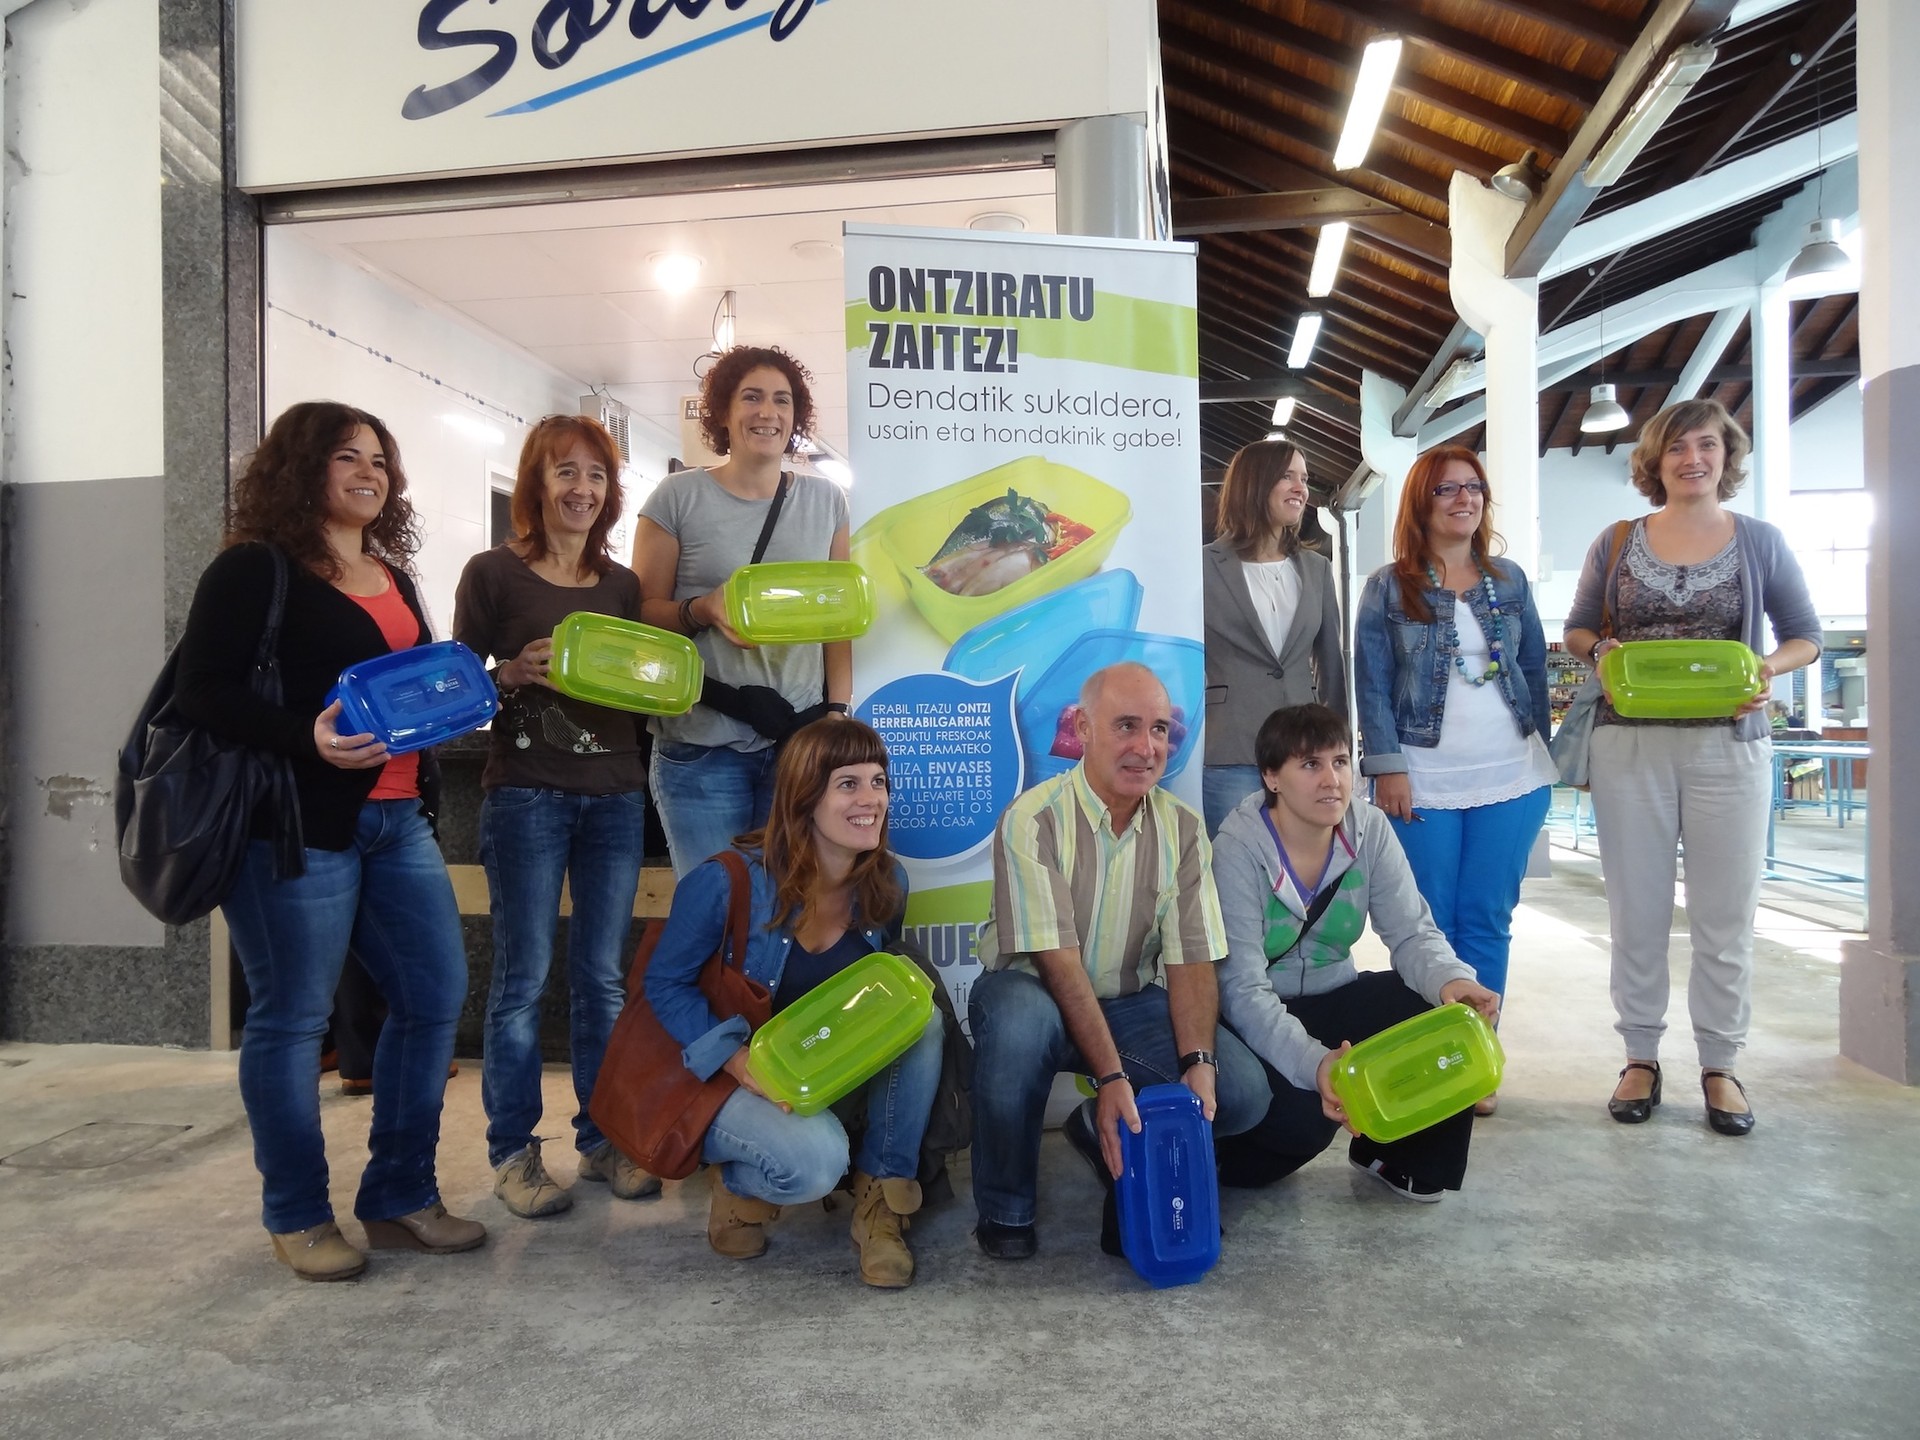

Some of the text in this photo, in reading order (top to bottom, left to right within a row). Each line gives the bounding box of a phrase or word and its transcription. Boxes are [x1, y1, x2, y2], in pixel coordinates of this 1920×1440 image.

[868, 265, 1095, 322] ONTZIRATU
[868, 322, 1018, 373] ZAITEZ!
[868, 382, 1182, 420] Dendatik sukaldera,
[868, 420, 1182, 451] usain eta hondakinik gabe!
[872, 702, 991, 715] ERABIL ITZAZU ONTZI
[872, 716, 991, 728] BERRERABILGARRIAK
[880, 730, 991, 742] RODUKTU FRESKOAK
[886, 743, 991, 756] XERA ERAMATEKO
[890, 760, 991, 776] ÍLIZA ENVASES
[889, 775, 992, 789] UTILIZABLES
[912, 791, 964, 802] LLEVARTE
[970, 790, 992, 801] LOS
[888, 802, 992, 815] RODUCTOS
[888, 816, 975, 829] ESCOS A CASA
